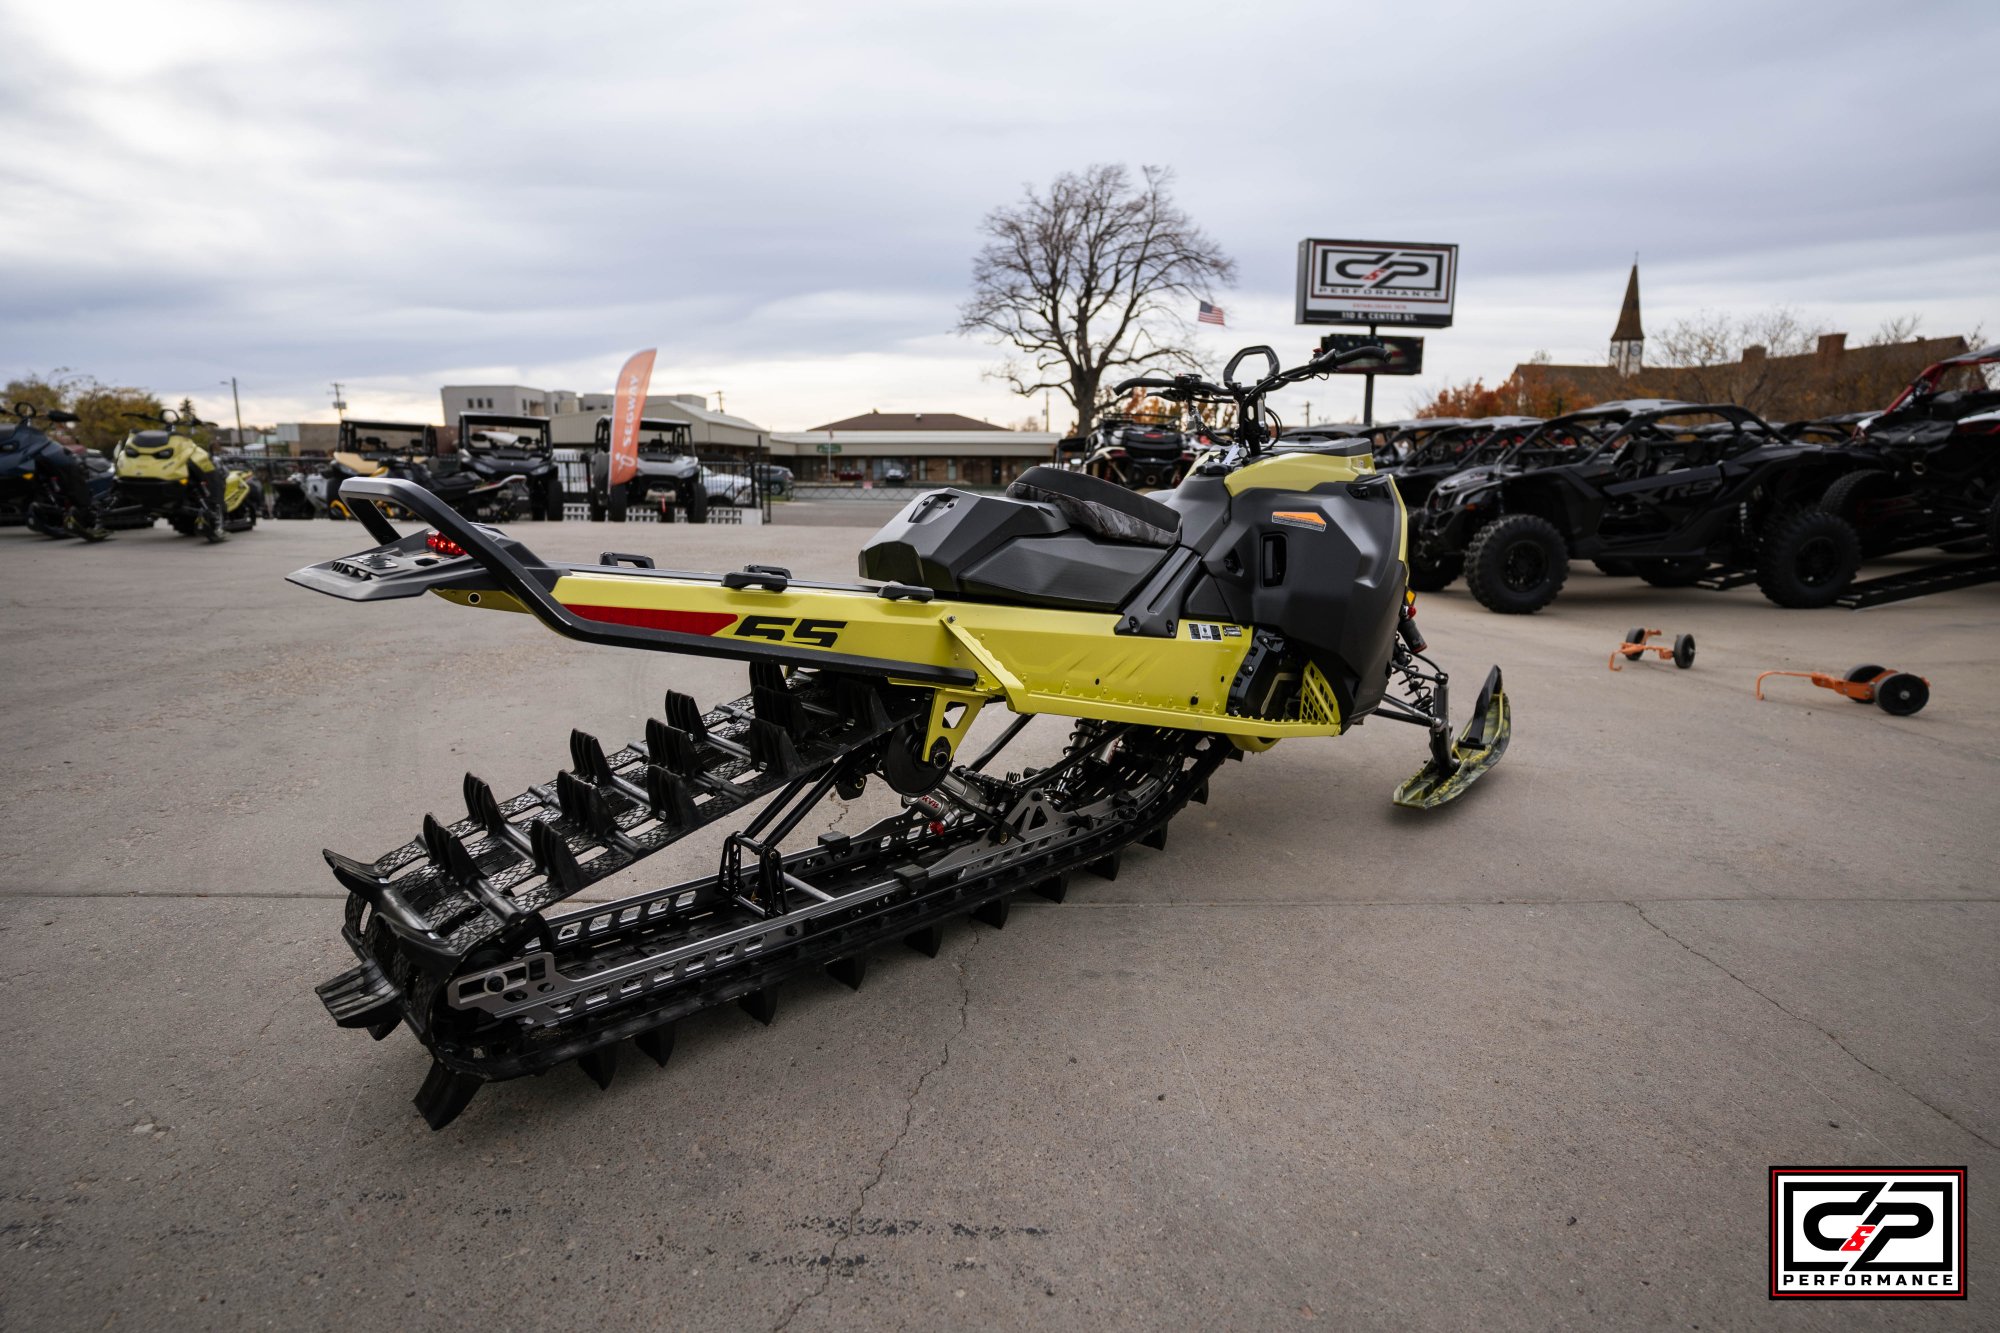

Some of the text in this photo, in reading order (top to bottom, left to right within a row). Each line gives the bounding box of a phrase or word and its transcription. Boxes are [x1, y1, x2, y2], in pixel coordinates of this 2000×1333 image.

[1318, 286, 1442, 297] PERFORMANCE
[1368, 312, 1401, 320] CENTER
[623, 375, 638, 448] SEGWAY
